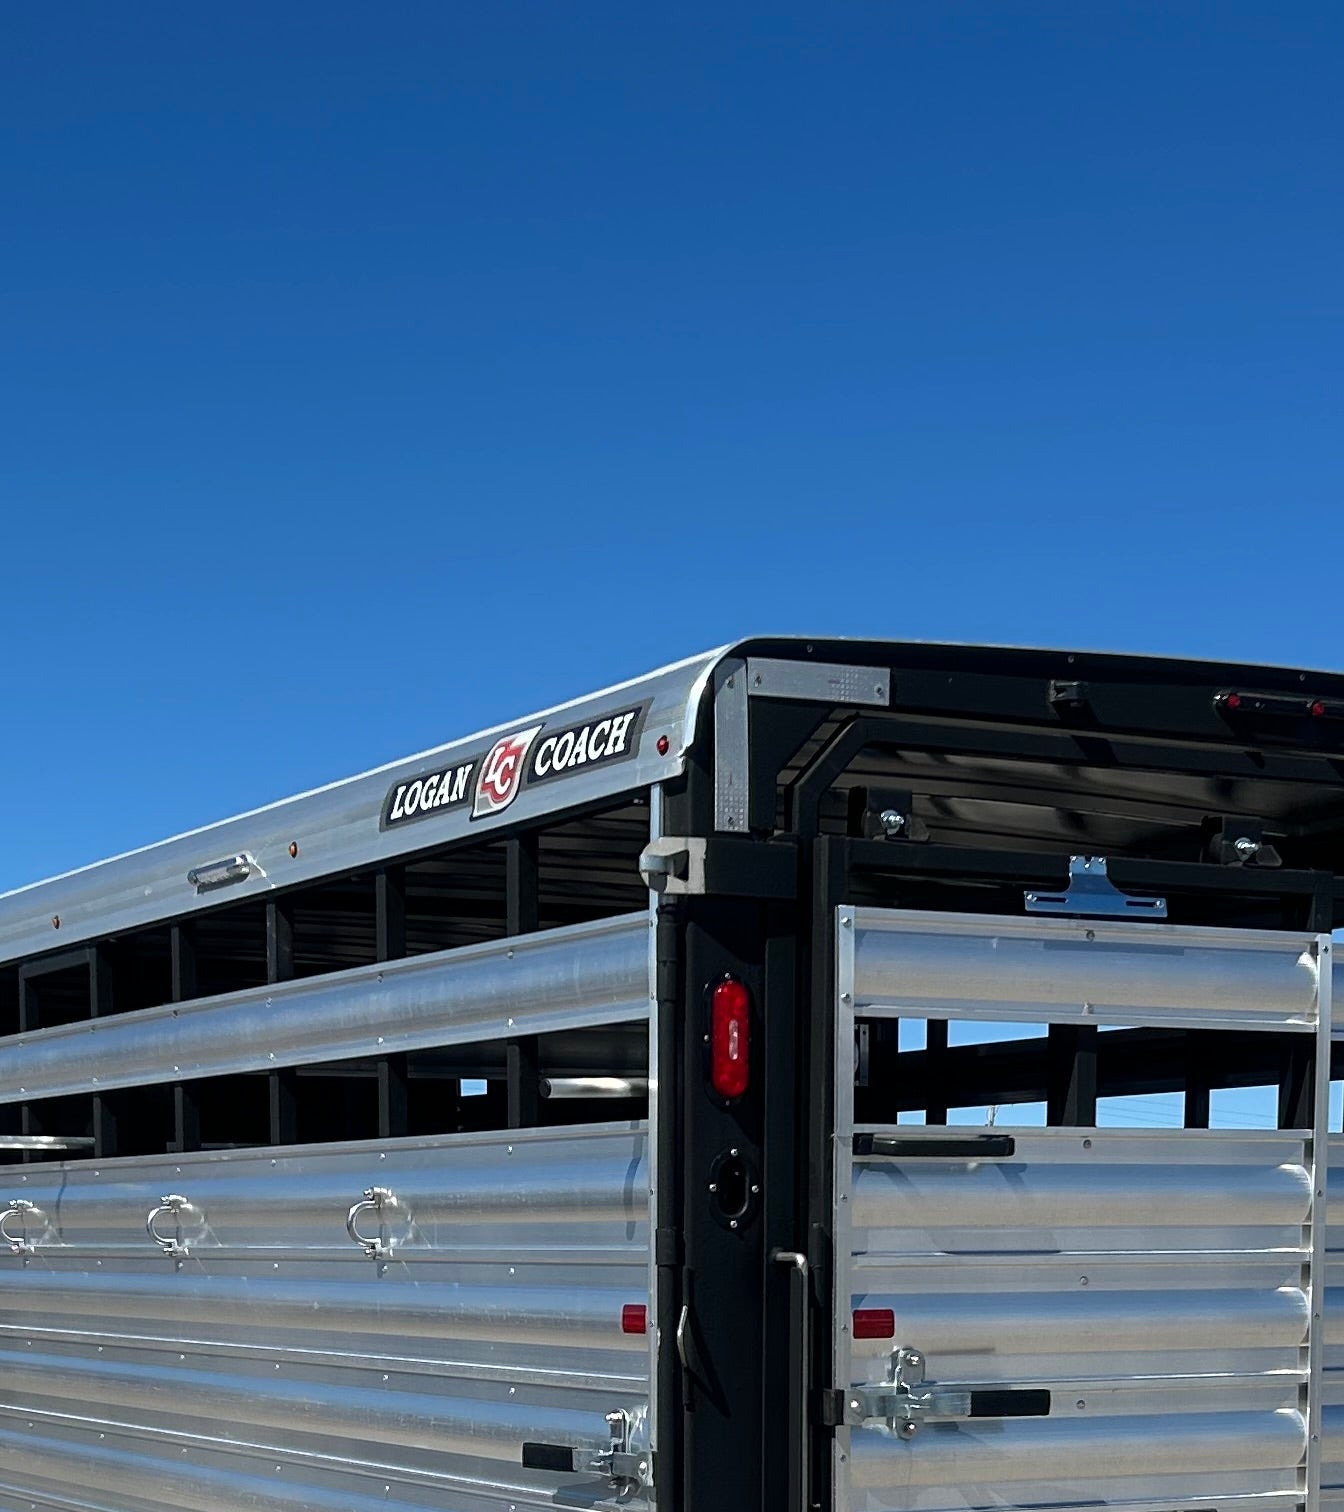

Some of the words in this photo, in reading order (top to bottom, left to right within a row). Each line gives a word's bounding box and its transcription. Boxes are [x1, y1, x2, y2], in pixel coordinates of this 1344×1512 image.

[390, 763, 473, 821] LOGAN
[484, 746, 516, 796] LC
[534, 711, 635, 777] COACH
